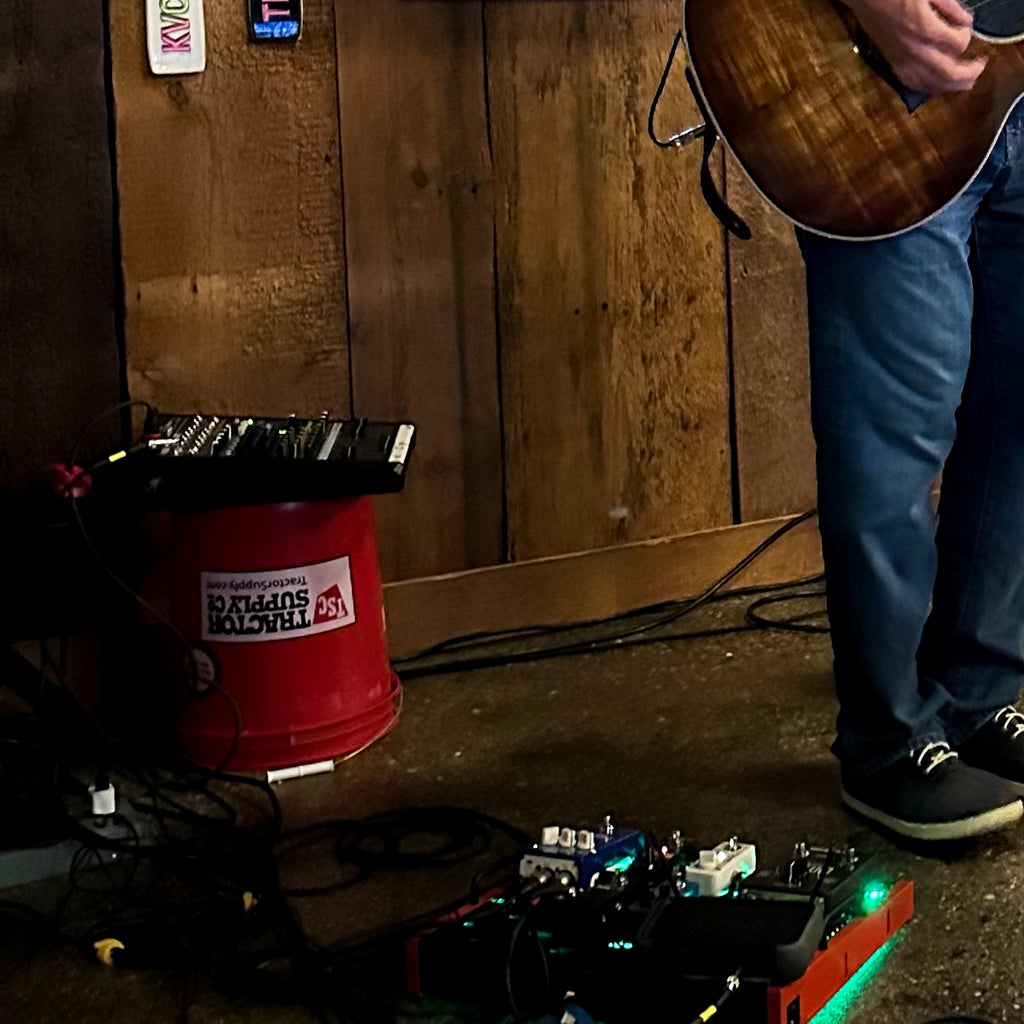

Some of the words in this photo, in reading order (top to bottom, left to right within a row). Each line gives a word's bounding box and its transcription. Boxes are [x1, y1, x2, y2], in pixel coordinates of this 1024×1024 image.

[227, 589, 309, 615] SUPPLY
[318, 595, 346, 618] TSC
[207, 609, 311, 635] TRACTOR
